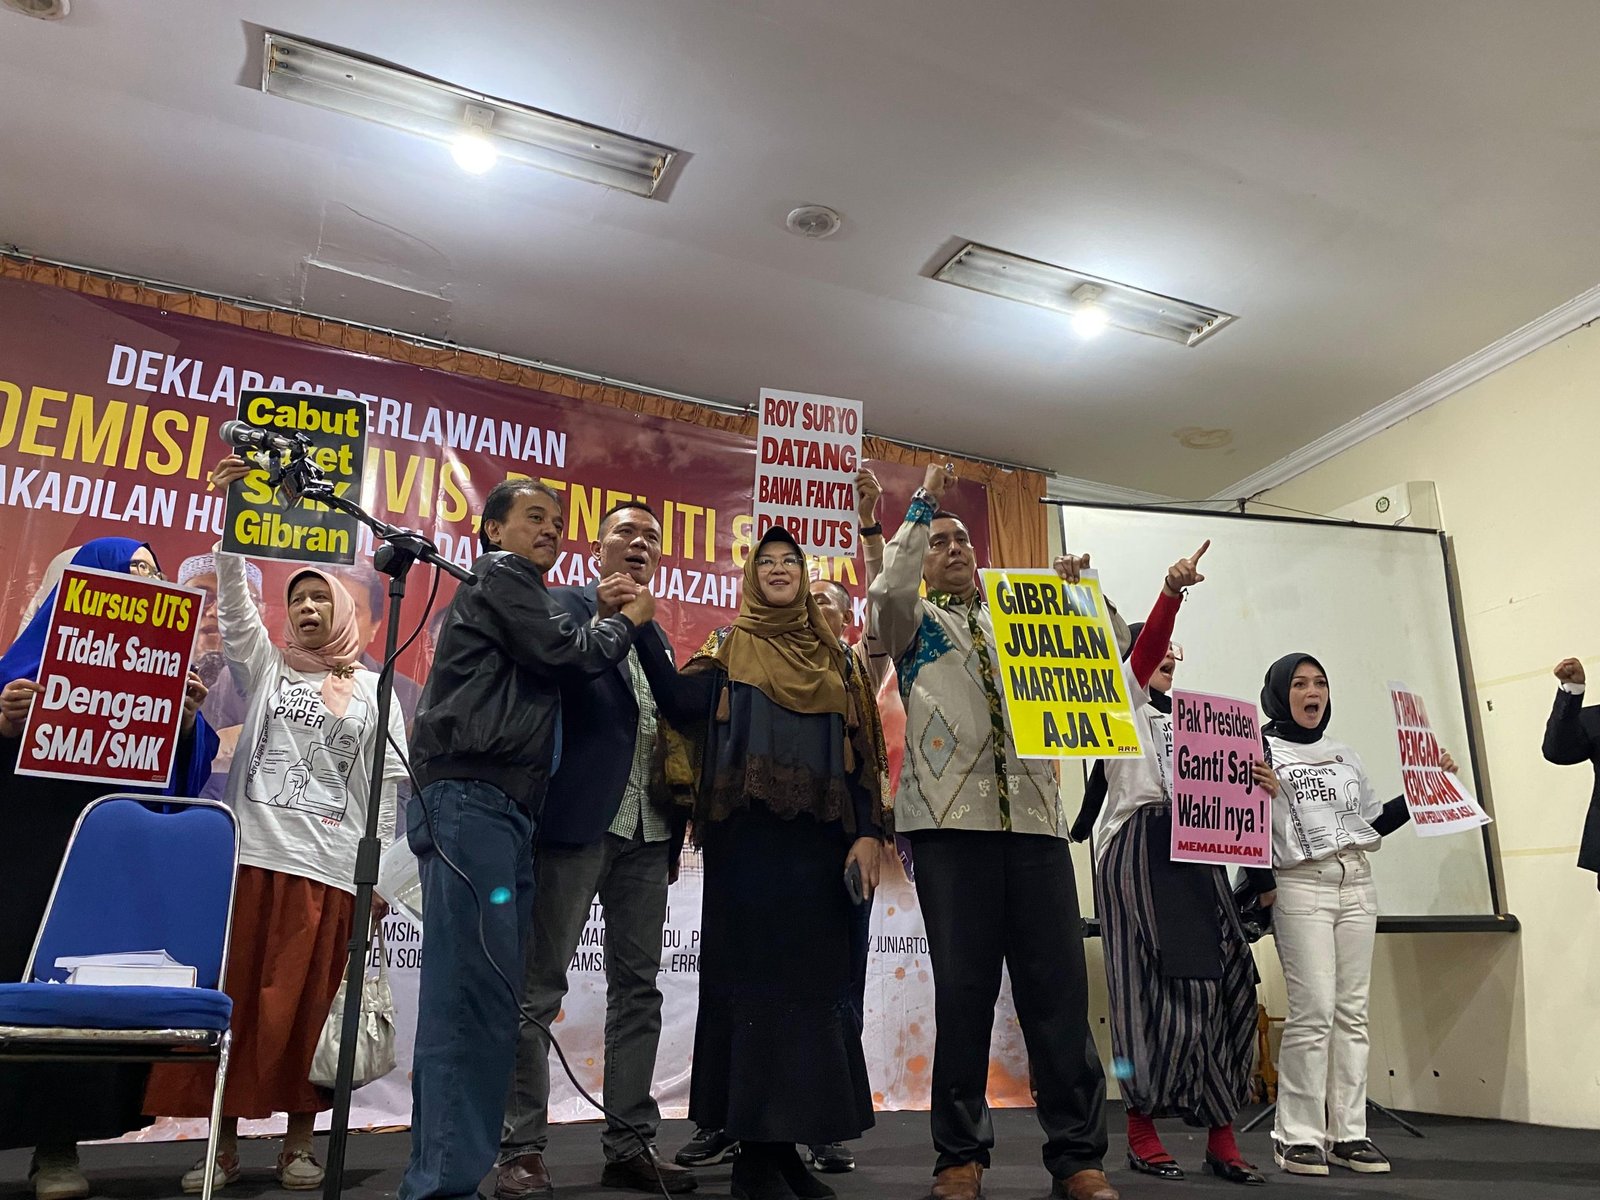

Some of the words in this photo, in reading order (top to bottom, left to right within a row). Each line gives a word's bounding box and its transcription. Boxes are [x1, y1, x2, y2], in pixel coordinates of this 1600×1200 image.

[247, 397, 360, 438] Cabut
[764, 398, 798, 427] ROY
[802, 403, 858, 435] SURYO
[761, 437, 857, 473] DATANG
[759, 475, 802, 507] BAWA
[805, 481, 855, 511] FAKTA
[234, 509, 349, 554] Gibran
[813, 519, 853, 549] UTS
[63, 578, 149, 625] Kursus
[152, 592, 192, 632] UTS
[996, 581, 1099, 618] GIBRAN
[56, 626, 118, 668] Tidak
[123, 637, 182, 678] Sama
[1004, 623, 1111, 660] JUALAN
[42, 674, 172, 731] Dengan
[1009, 666, 1121, 704] MARTABAK
[273, 706, 326, 730] PAPER
[280, 695, 319, 713] WHITE
[1178, 698, 1201, 733] Pak
[32, 724, 165, 772] SMA/SMK
[1043, 712, 1099, 748] AJA
[1101, 712, 1115, 748] !
[1397, 729, 1440, 768] DENGAN
[1178, 744, 1224, 782] Ganti
[1228, 750, 1260, 796] Saj
[1290, 777, 1326, 792] WHITE
[1402, 769, 1464, 808] KEPALSUAN
[1295, 787, 1337, 805] PAPER
[1177, 793, 1222, 832] Wakil
[1225, 805, 1256, 841] nya
[1259, 801, 1265, 833] !
[1177, 840, 1263, 857] MEMALUKAN
